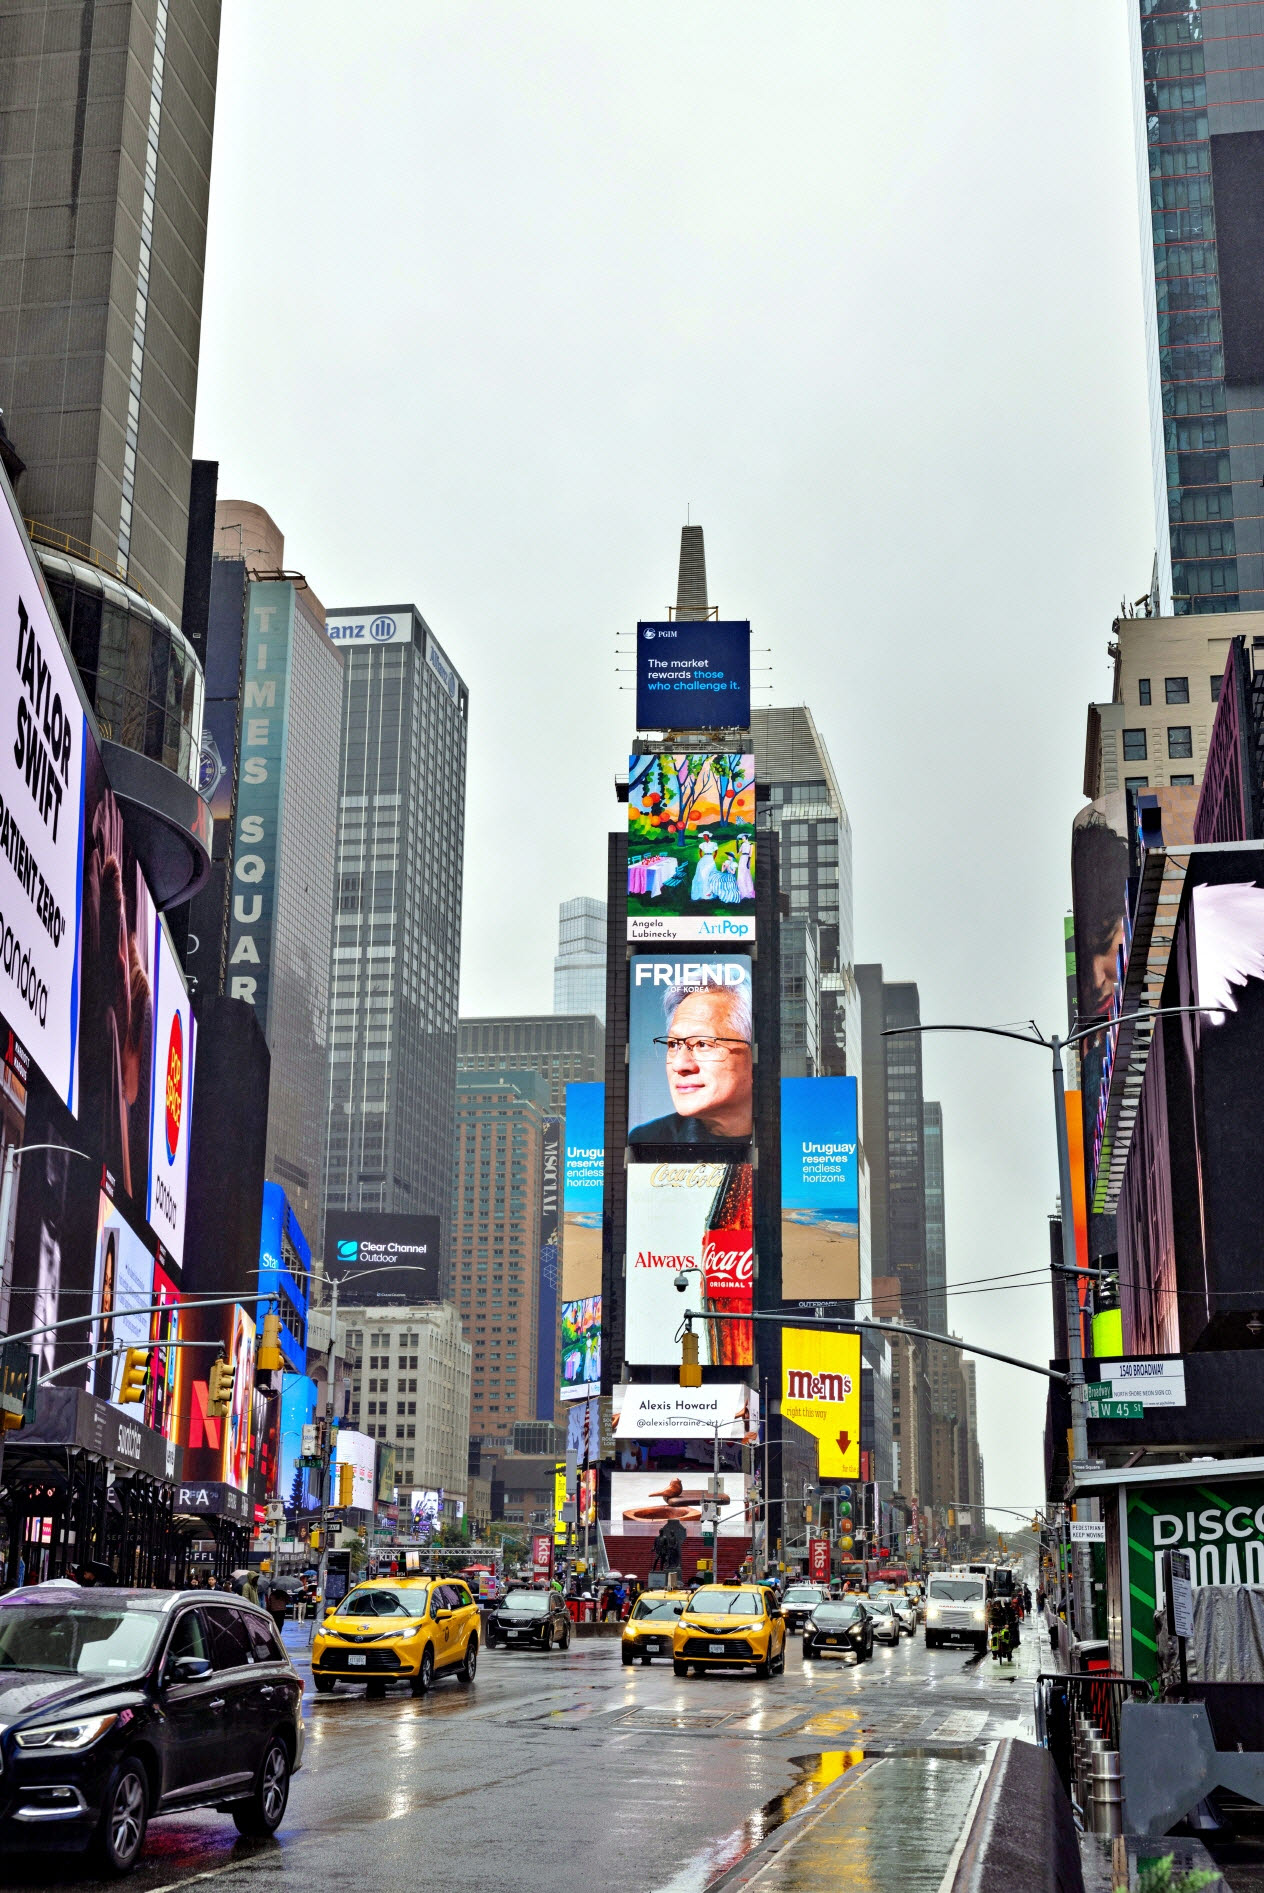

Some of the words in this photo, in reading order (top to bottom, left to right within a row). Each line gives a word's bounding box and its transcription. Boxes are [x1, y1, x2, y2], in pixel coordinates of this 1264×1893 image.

[658, 630, 678, 638] PGIM
[648, 659, 668, 668] The
[670, 659, 709, 668] market
[648, 671, 691, 679] rewards
[693, 671, 724, 679] those
[16, 594, 72, 789] TAYLOR
[648, 682, 671, 691] who
[673, 681, 727, 692] challenge
[729, 681, 741, 690] it.
[243, 606, 277, 785] TIMES
[14, 696, 63, 845] SWIFT
[632, 919, 664, 928] Angela
[698, 920, 749, 937] ArtPop
[632, 930, 677, 939] Lubinecky
[635, 963, 746, 986] FRIEND
[802, 1142, 857, 1155] Uruguay
[802, 1155, 848, 1163] reserves
[566, 1168, 604, 1177] endless
[802, 1164, 842, 1173] endless
[802, 1174, 846, 1183] horizons
[360, 1241, 386, 1252] Clear
[387, 1243, 427, 1253] Channel
[360, 1252, 398, 1263] Outdoor
[634, 1251, 698, 1272] Always.
[1119, 1365, 1133, 1377] 1540
[1133, 1363, 1164, 1376] BROADWAY
[1088, 1385, 1111, 1398] Broadway
[639, 1400, 671, 1410] Alexis
[675, 1400, 718, 1410] Howard
[1101, 1403, 1111, 1416] W
[1116, 1403, 1129, 1416] 45
[1133, 1404, 1141, 1412] St
[786, 1407, 802, 1419] right
[802, 1407, 815, 1418] this
[815, 1409, 827, 1420] way
[538, 1537, 551, 1564] tkts
[814, 1541, 827, 1569] tkts
